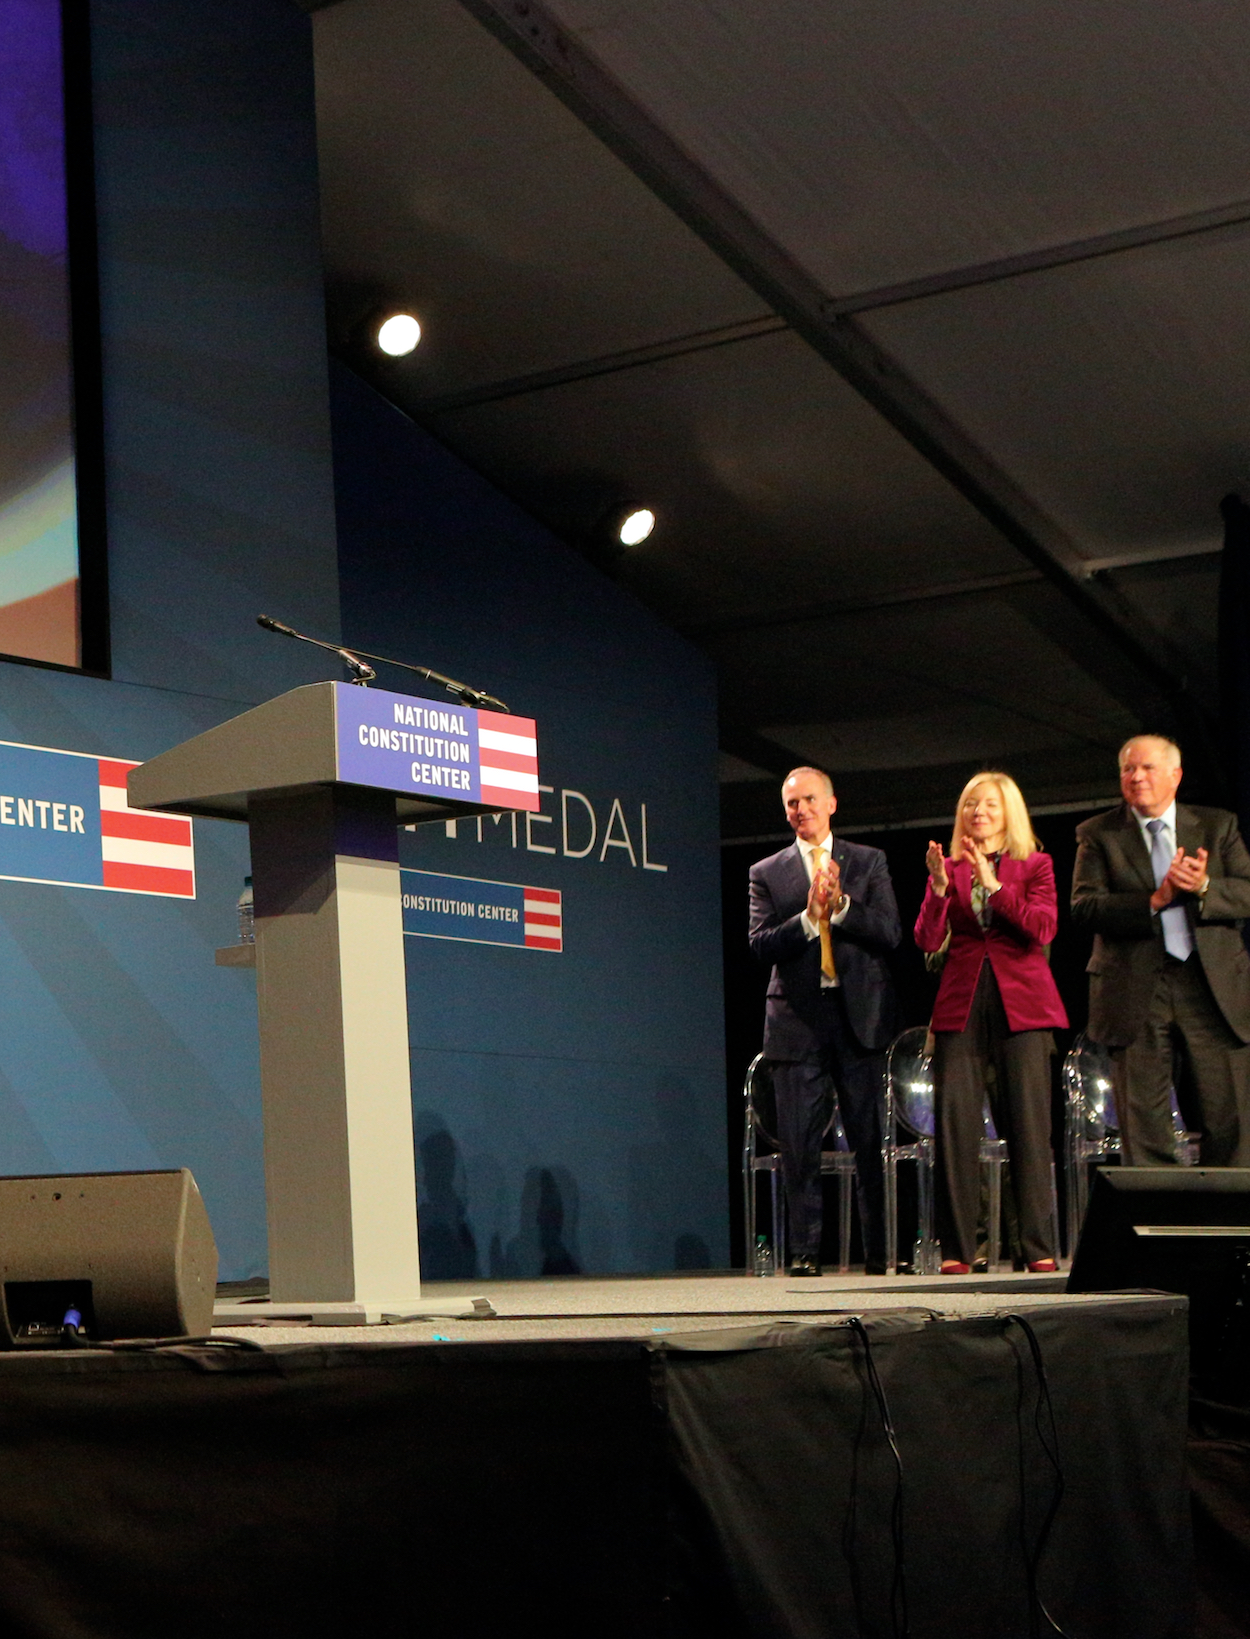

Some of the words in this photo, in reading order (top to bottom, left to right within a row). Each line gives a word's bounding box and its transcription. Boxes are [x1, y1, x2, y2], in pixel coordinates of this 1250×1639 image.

[393, 703, 469, 736] NATIONAL
[358, 724, 470, 764] CONSTITUTION
[411, 761, 471, 791] CENTER
[401, 893, 475, 918] ONSTITUTION
[477, 903, 519, 923] CENTER
